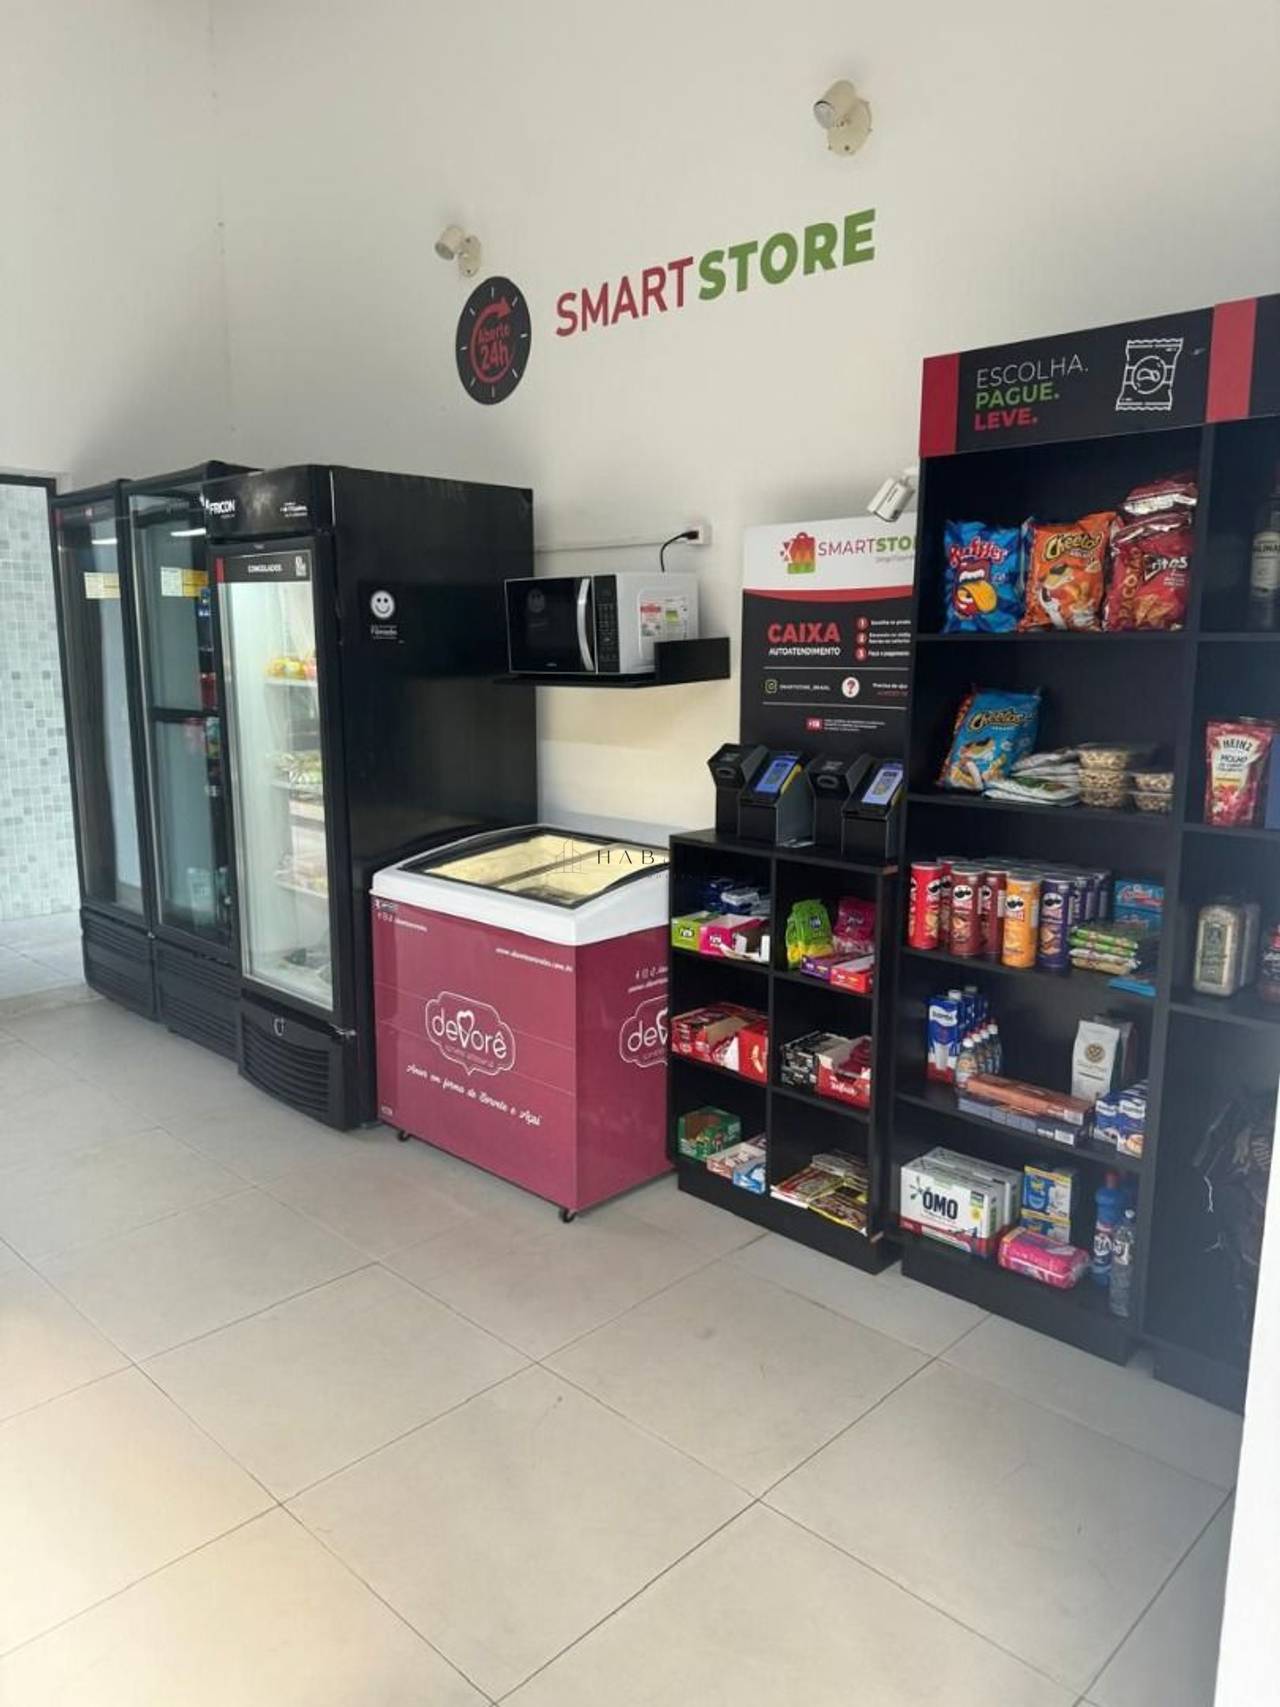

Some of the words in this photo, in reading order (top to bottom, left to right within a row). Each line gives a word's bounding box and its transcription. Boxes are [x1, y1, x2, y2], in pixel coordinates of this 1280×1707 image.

[480, 339, 508, 368] 24h
[976, 354, 1089, 389] ESCOLHA.
[975, 382, 1060, 411] PAGUE.
[974, 406, 1039, 432] LEVE.
[767, 622, 841, 643] CAIXA
[768, 646, 841, 657] AUTOATENDIMENTO
[1223, 738, 1253, 752] HEINZ
